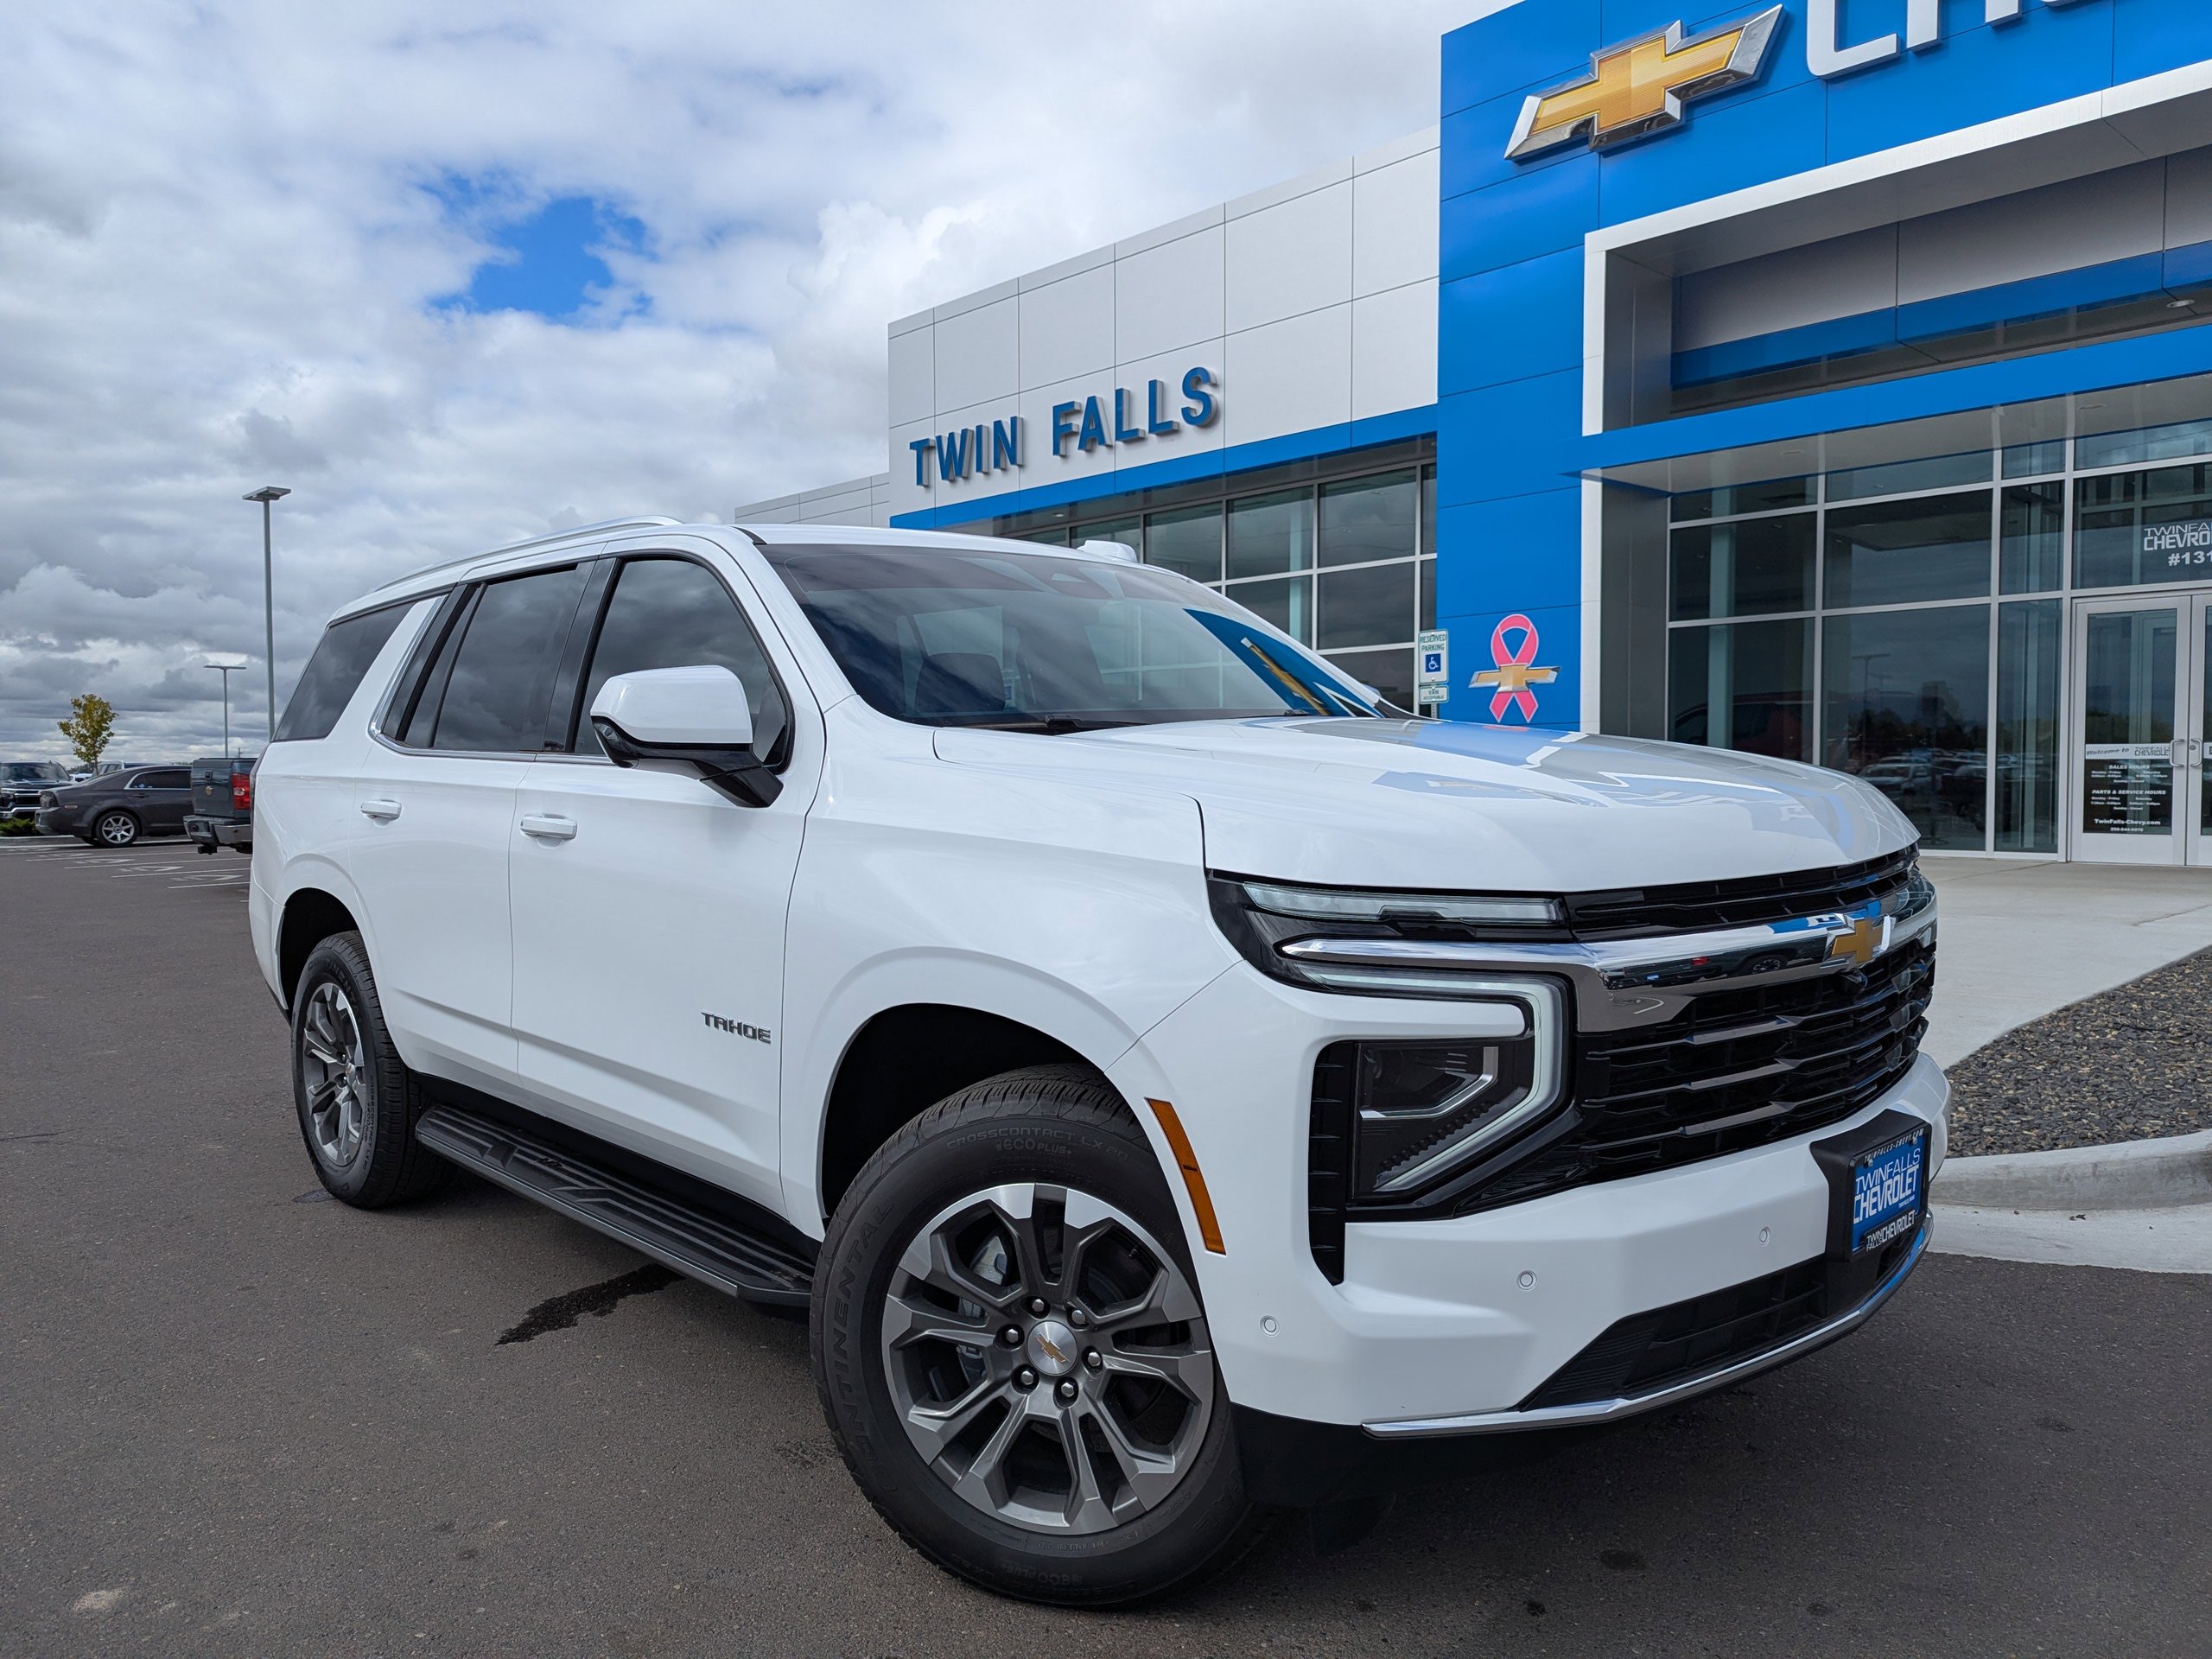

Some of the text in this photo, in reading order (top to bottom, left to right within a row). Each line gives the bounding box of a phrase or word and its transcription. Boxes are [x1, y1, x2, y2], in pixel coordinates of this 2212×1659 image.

[910, 366, 1218, 487] TWIN FALLS
[2144, 523, 2212, 537] TWINFA
[2144, 531, 2212, 551] CHEVRO
[1420, 634, 1446, 644] RESERVED
[1421, 644, 1445, 652] PARKING
[701, 1012, 771, 1044] TAHOE
[947, 1127, 1076, 1149] CROSSCONTACT
[1081, 1136, 1103, 1150] LX
[1855, 1147, 1921, 1195] TWINFALLS
[1853, 1164, 1920, 1224] CHEVROLET
[1866, 1229, 1883, 1244] TWIN
[1881, 1209, 1916, 1243] CHEVROLET
[1866, 1237, 1883, 1252] FALLS
